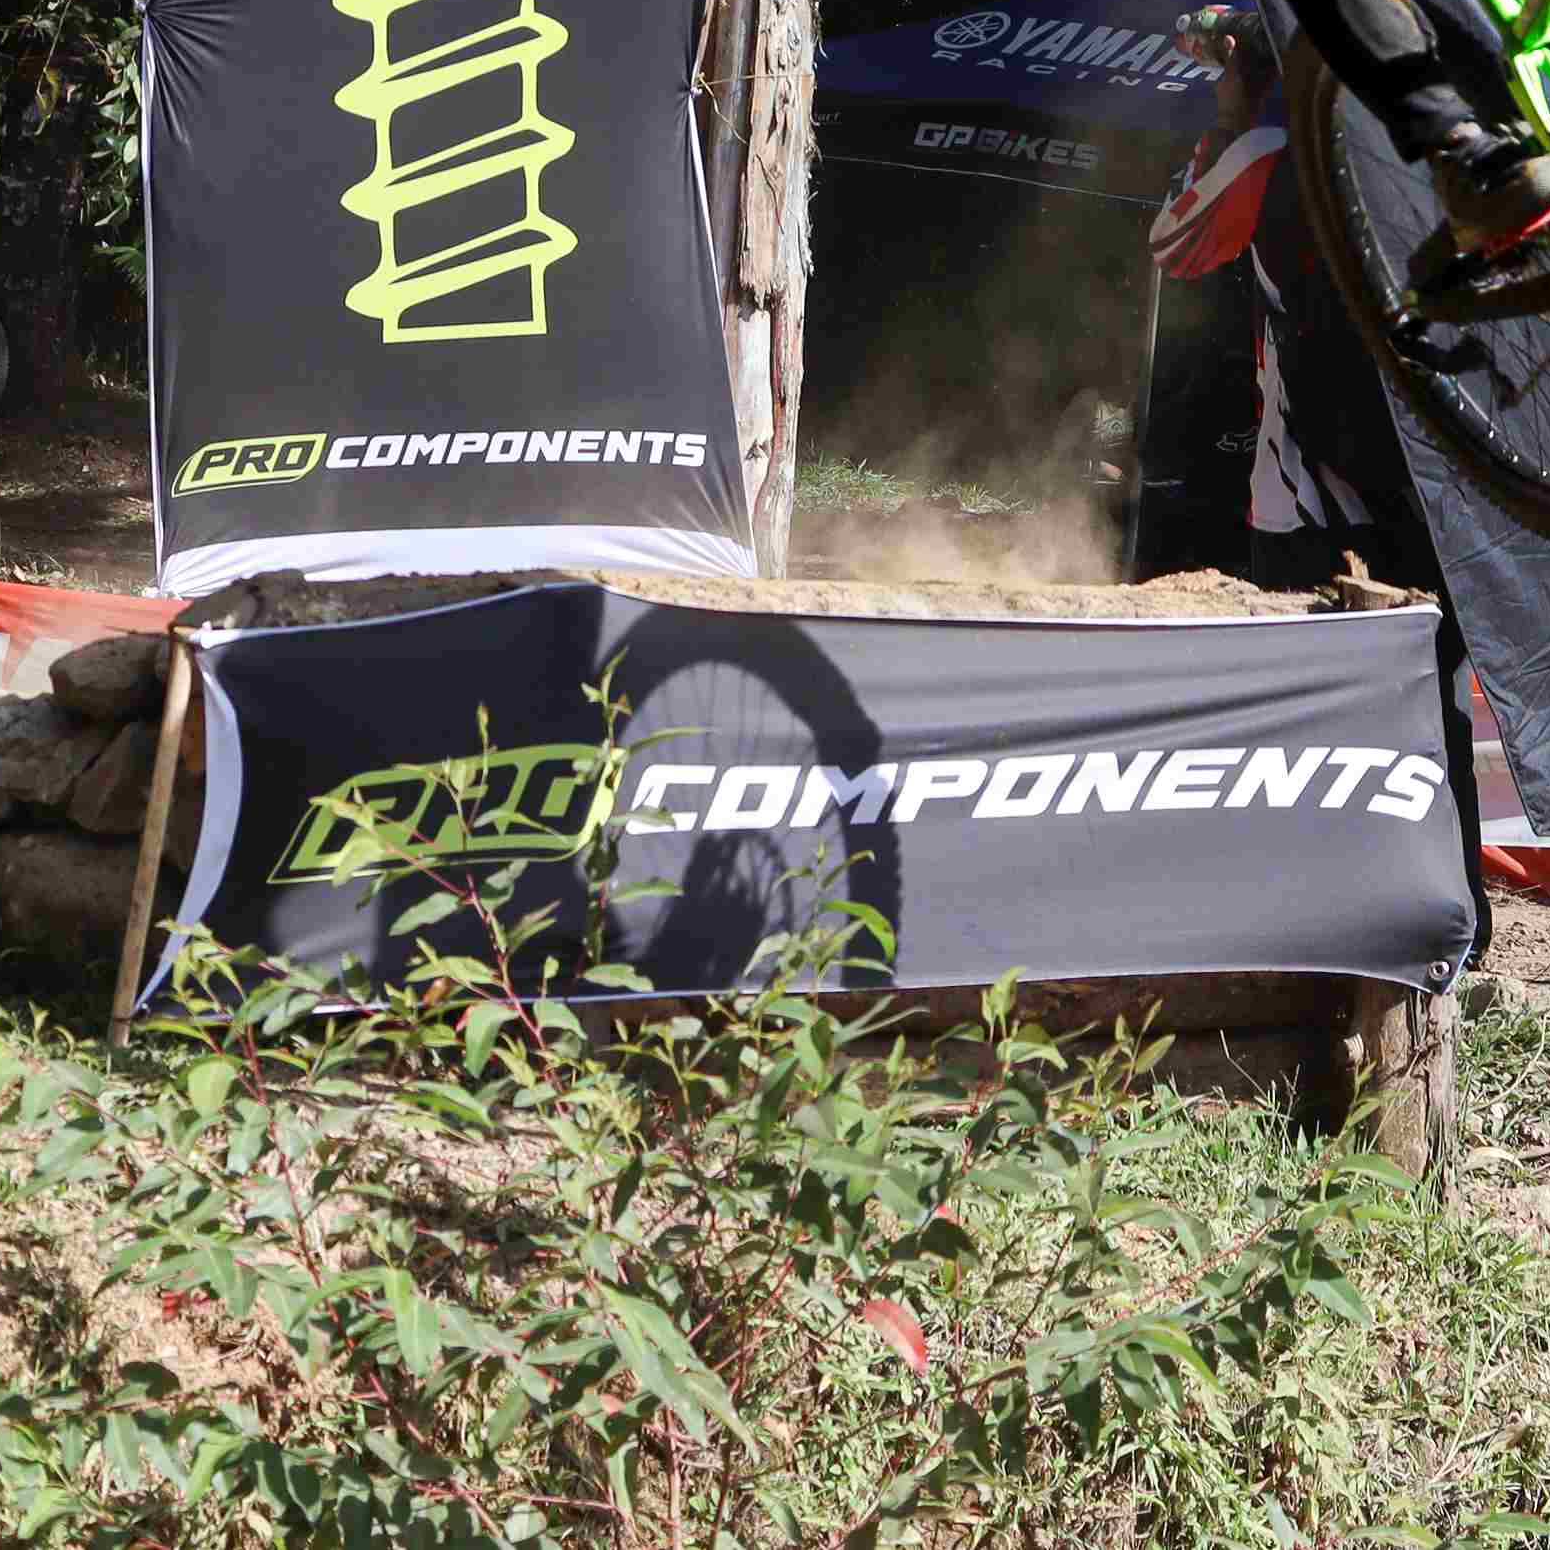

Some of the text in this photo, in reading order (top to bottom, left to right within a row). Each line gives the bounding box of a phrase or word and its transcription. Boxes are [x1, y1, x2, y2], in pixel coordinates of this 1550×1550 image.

[931, 49, 1189, 92] RACING
[192, 430, 707, 481] PRO COMPONENTS
[627, 746, 1444, 835] COMPONENTS
